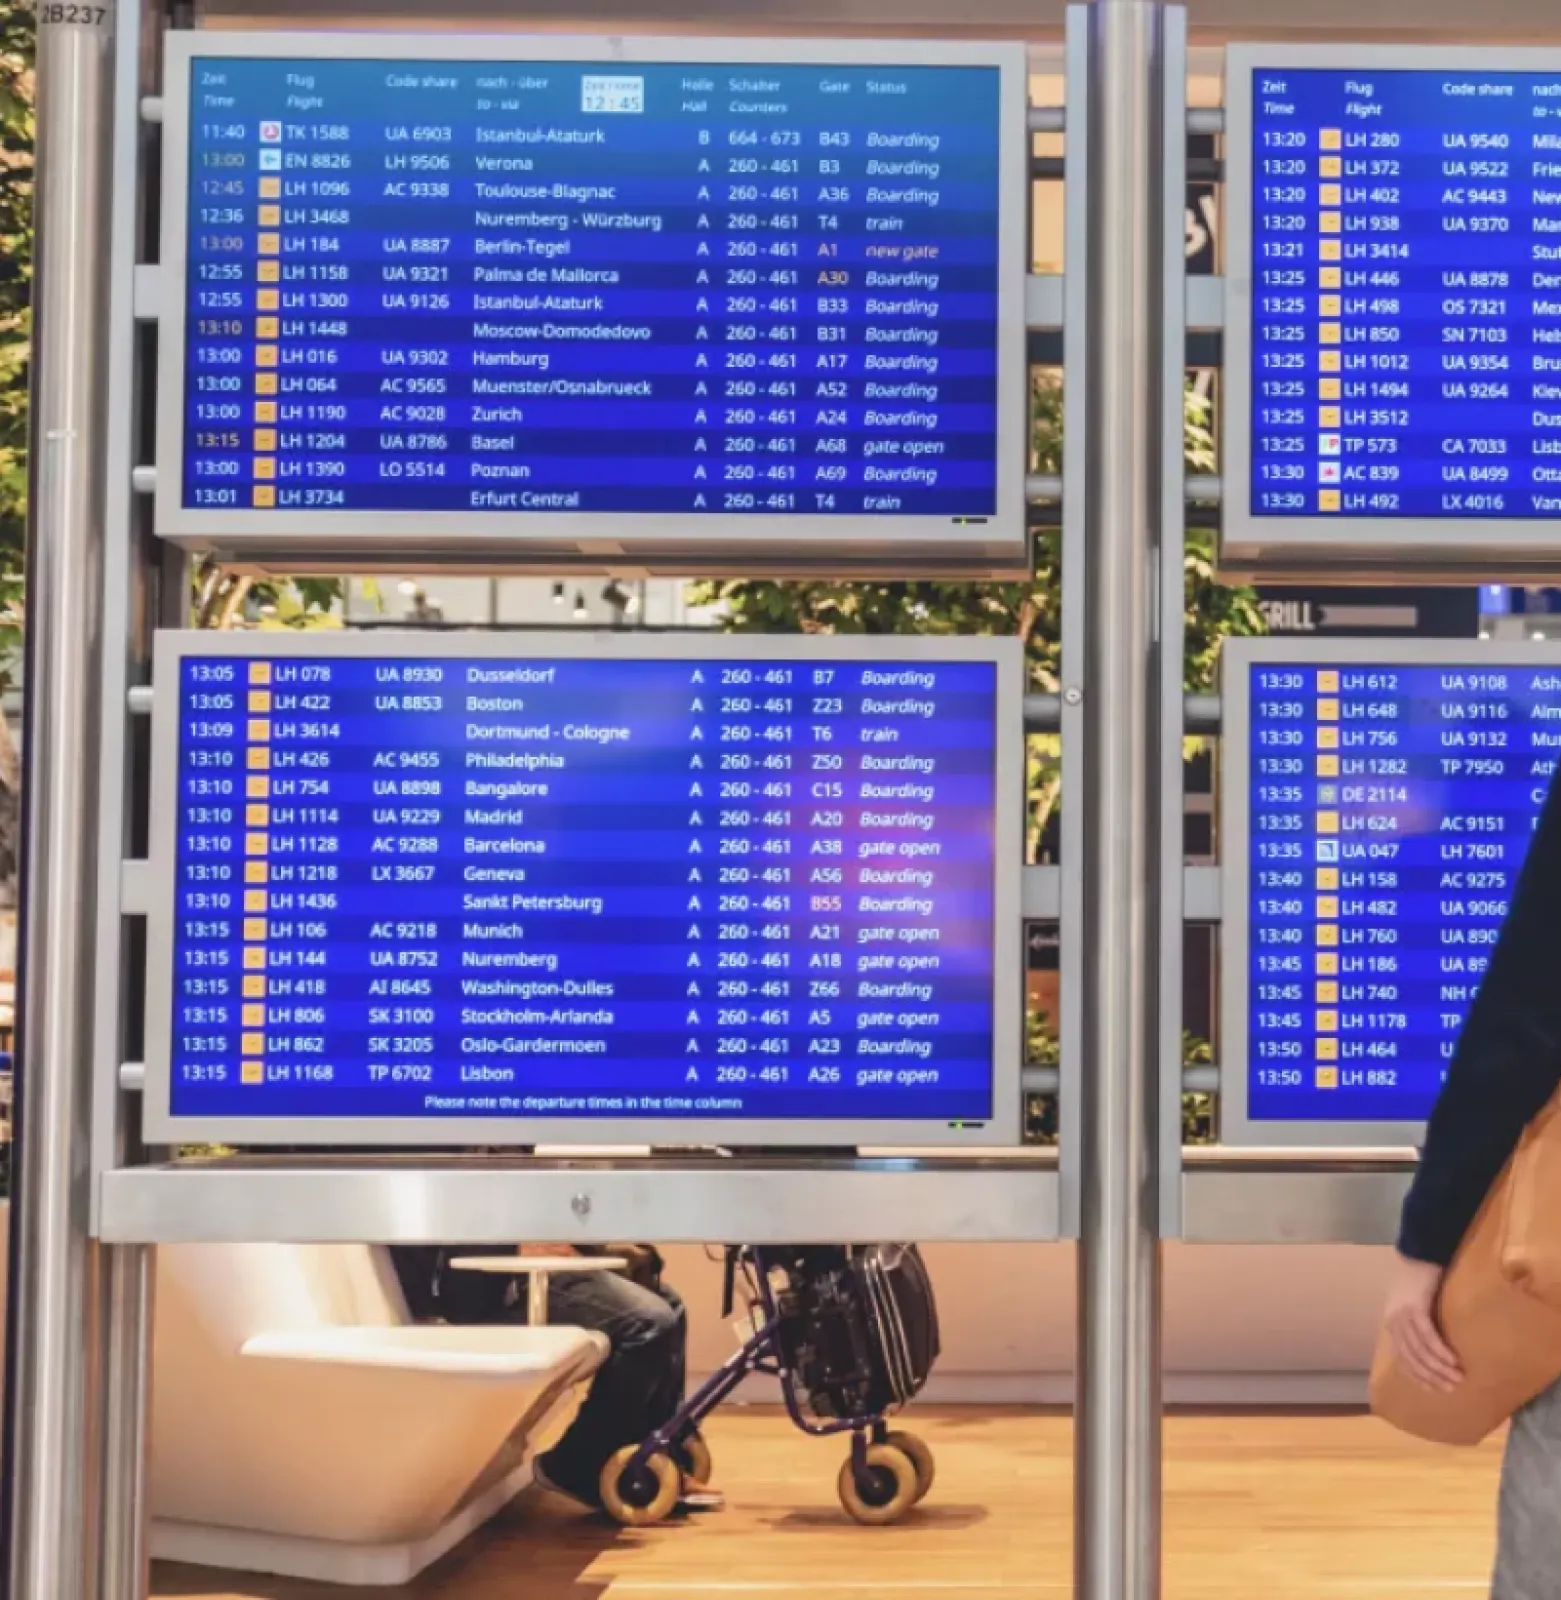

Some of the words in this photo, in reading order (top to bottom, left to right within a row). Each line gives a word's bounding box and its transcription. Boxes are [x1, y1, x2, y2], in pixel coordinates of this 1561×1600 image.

[1262, 79, 1287, 94] Zeit
[1344, 79, 1374, 98] Flug
[1441, 81, 1475, 96] Code
[1479, 83, 1514, 96] share
[1263, 101, 1295, 115] Time
[1344, 102, 1383, 119] Flight
[475, 126, 606, 144] Istanbul-Ataturk
[865, 131, 940, 152] Boarding
[1263, 131, 1306, 147] 13:20
[475, 155, 533, 171] Verona
[473, 182, 616, 204] Toulouse-Blagnac
[473, 237, 571, 259] Berlin-Tegel
[1262, 241, 1303, 258] 13:21
[473, 266, 523, 282] Palma
[526, 267, 547, 282] de
[551, 266, 620, 284] Mallorca
[473, 293, 603, 311] Istanbul-Ataturk
[473, 321, 652, 340] Moscow-Domodedovo
[198, 346, 242, 364] 13:00
[473, 350, 549, 371] Hamburg
[815, 353, 848, 368] A17
[863, 354, 939, 374] Boarding
[471, 378, 652, 396] Muenster/Osnabrueck
[471, 405, 523, 422] Zurich
[471, 434, 515, 451] Basel
[470, 461, 531, 478] Poznan
[194, 487, 236, 504] 13:01
[470, 490, 516, 507] Erfurt
[520, 490, 581, 507] Central
[863, 494, 901, 510] train
[465, 666, 556, 683] Dusseldorf
[1259, 672, 1304, 689] 13:30
[465, 695, 524, 712] Boston
[1259, 701, 1304, 718] 13:30
[465, 723, 550, 740] Dortmund
[563, 723, 631, 744] Cologne
[859, 726, 899, 743] train
[1259, 729, 1303, 746] 13:30
[465, 751, 565, 772] Philadelphia
[1259, 758, 1303, 774] 13:30
[1341, 758, 1364, 775] LH
[1369, 758, 1408, 775] 1282
[1439, 758, 1462, 775] TP
[1465, 758, 1505, 775] 7950
[188, 778, 233, 795] 13:10
[464, 779, 549, 801] Bangalore
[811, 781, 843, 798] C15
[463, 807, 524, 825] Madrid
[1258, 813, 1303, 830] 13:35
[463, 836, 547, 854] Barcelona
[1258, 842, 1302, 859] 13:35
[463, 865, 525, 881] Geneva
[462, 893, 508, 910] Sankt
[512, 893, 604, 915] Petersburg
[1258, 899, 1303, 915] 13:40
[462, 922, 523, 939] Munich
[1259, 928, 1302, 944] 13:40
[461, 951, 558, 972] Nuremberg
[1258, 955, 1302, 972] 13:45
[460, 979, 614, 1000] Washington-Dulles
[857, 980, 933, 1001] Boarding
[460, 1007, 615, 1025] Stockholm-Arlanda
[459, 1037, 607, 1053] Oslo-Gardermoen
[459, 1064, 515, 1082] Lisbon
[1258, 1068, 1302, 1086] 13:50
